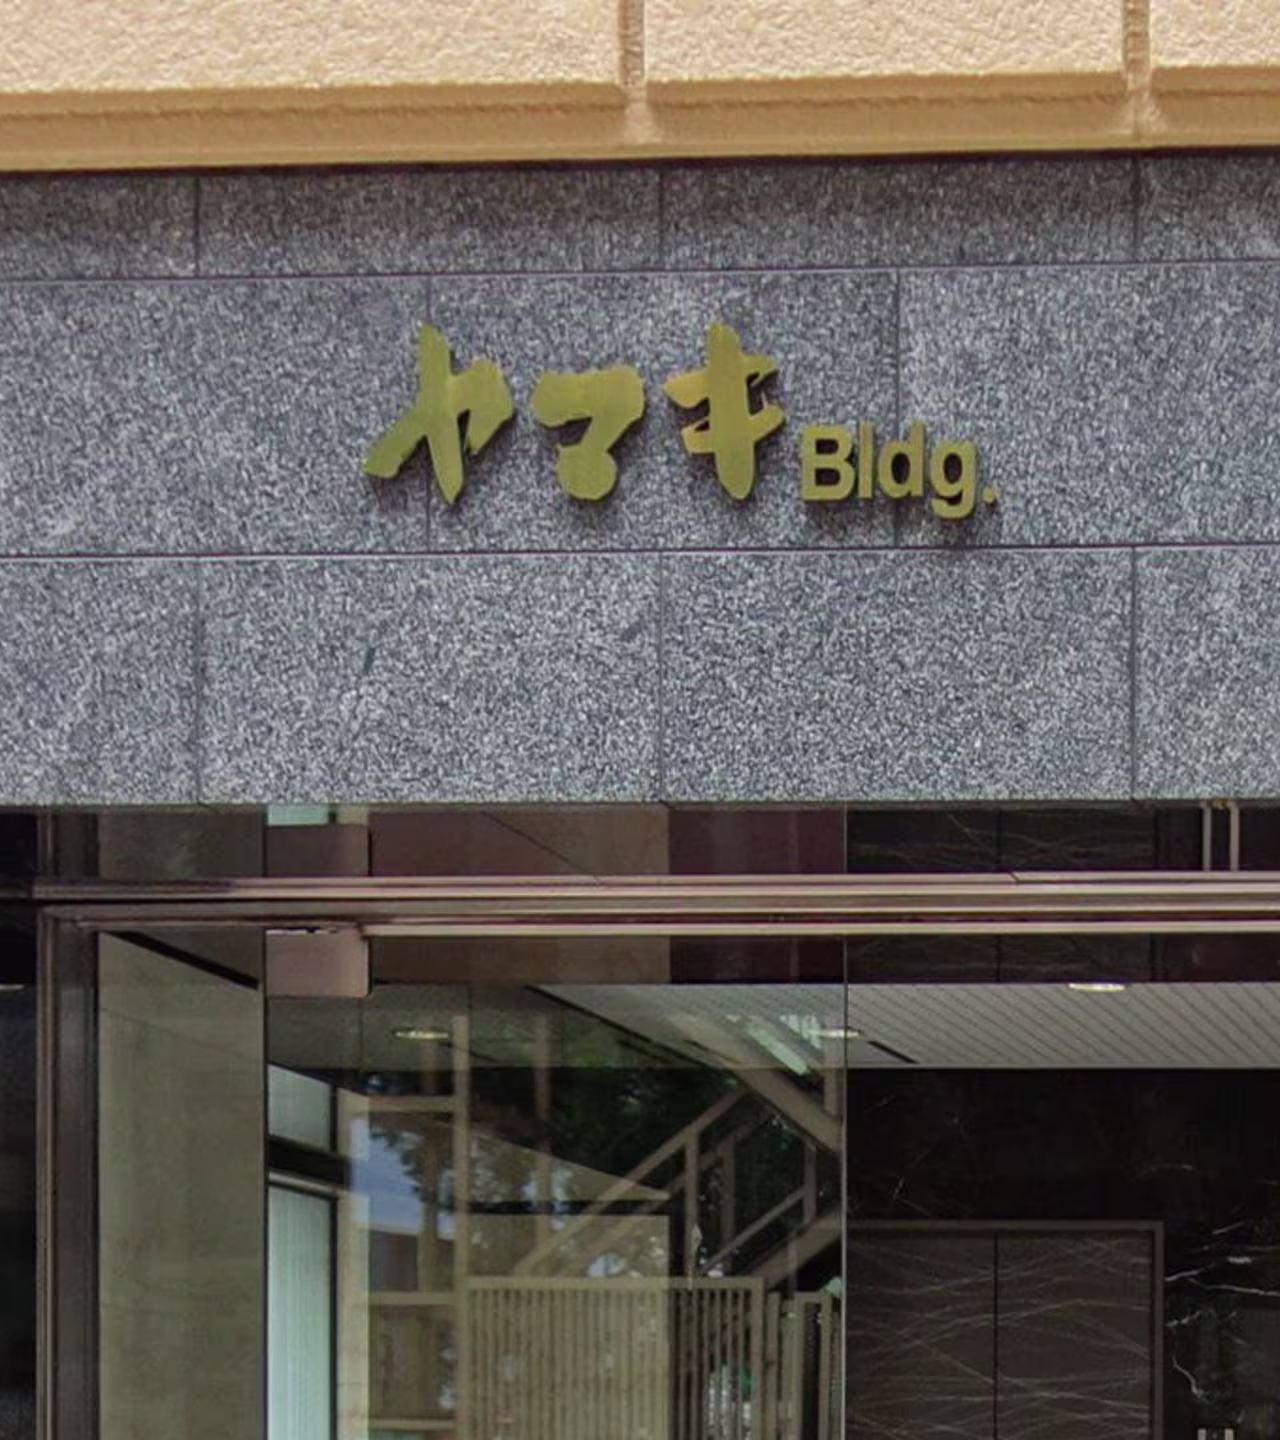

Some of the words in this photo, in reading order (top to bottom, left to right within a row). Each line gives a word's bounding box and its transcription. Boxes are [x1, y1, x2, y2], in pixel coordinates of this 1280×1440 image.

[360, 321, 786, 504] ヤマキ
[800, 421, 998, 520] Bldg.
